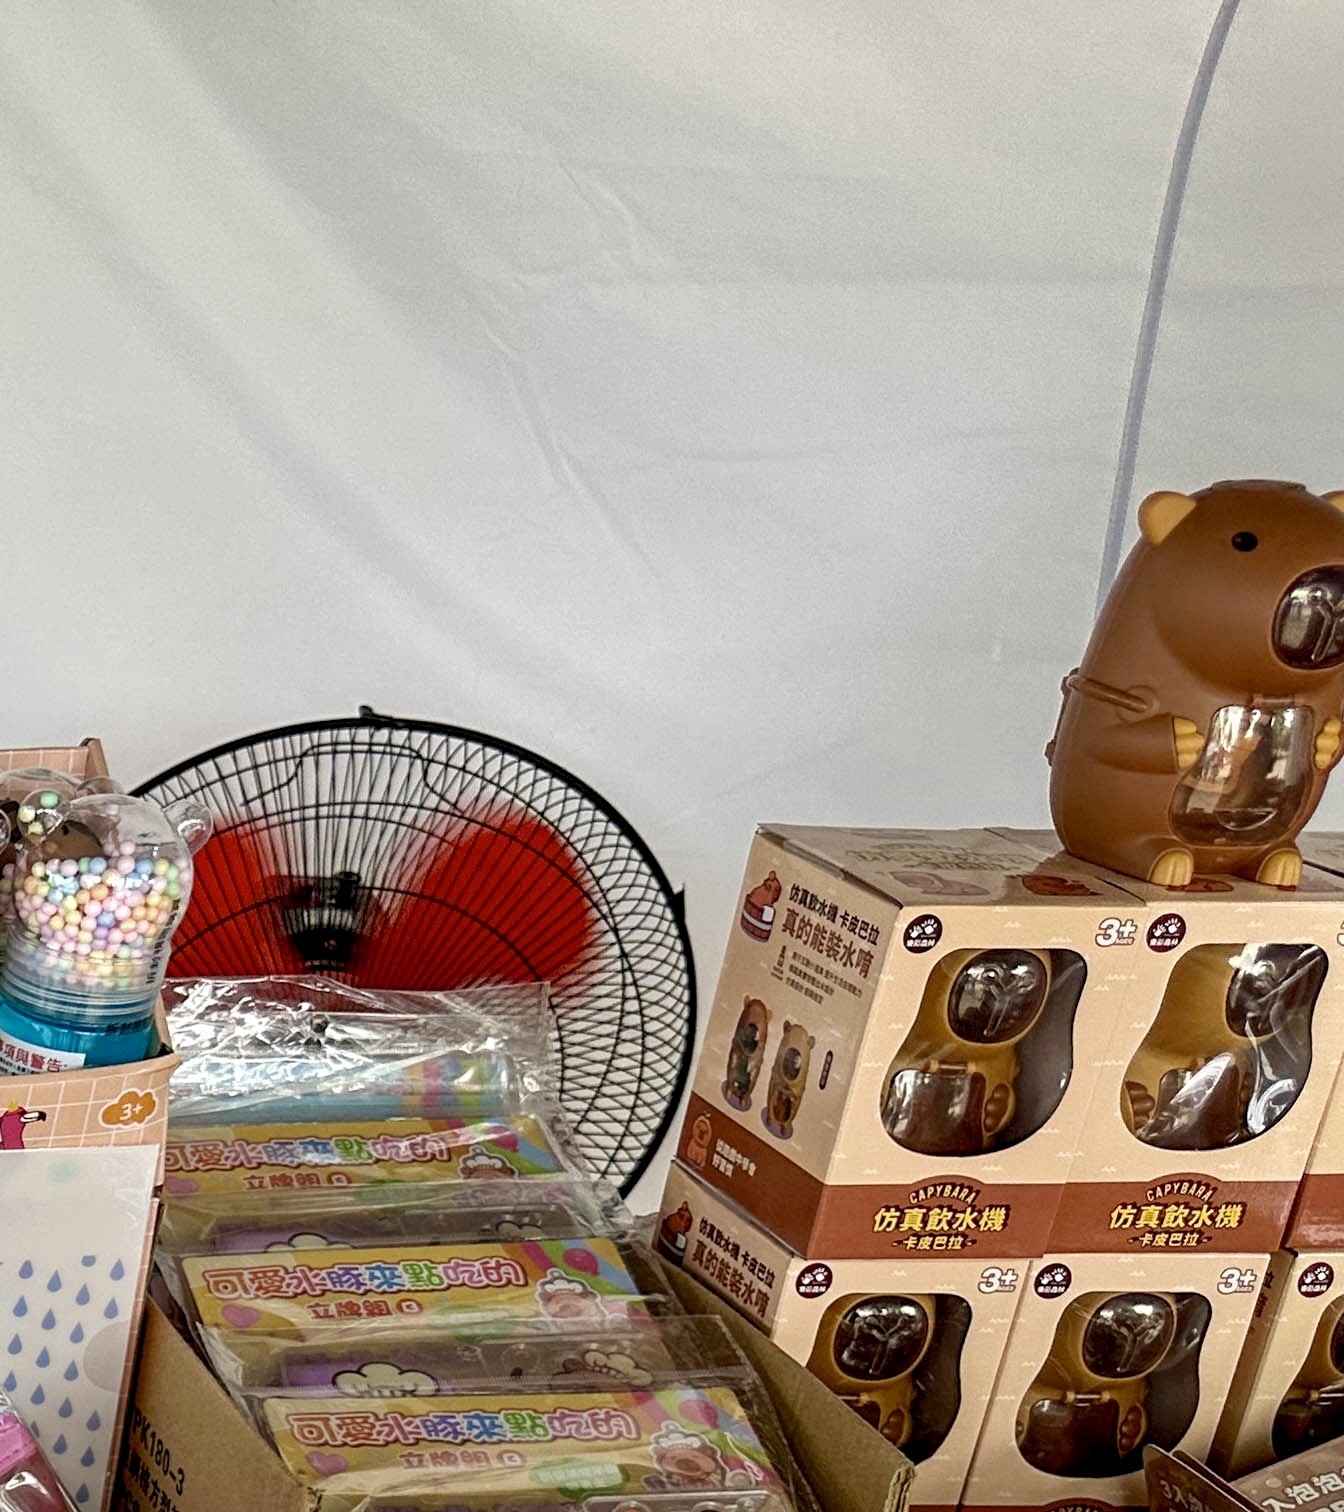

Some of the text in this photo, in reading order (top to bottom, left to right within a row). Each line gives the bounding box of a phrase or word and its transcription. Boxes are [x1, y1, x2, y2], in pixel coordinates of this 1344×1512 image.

[789, 883, 880, 945] 仿真飲水機 卡皮巴拉
[782, 908, 874, 979] 真的能裝水唷
[1095, 918, 1137, 947] 3+
[119, 1103, 144, 1119] 3+
[909, 1183, 976, 1204] CAPYBARA
[1146, 1180, 1213, 1202] CAPYBARA
[873, 1207, 1009, 1233] 仿真飲水機
[1110, 1204, 1244, 1229] 仿真飲水機
[204, 1255, 528, 1300] 可愛水豚來點吃的
[741, 1252, 776, 1289] 卡皮巴拉
[978, 1267, 1017, 1293] 3+
[1217, 1267, 1256, 1293] 3+
[306, 1300, 392, 1319] 立牌組
[287, 1409, 638, 1446] 可愛水豚來點吃的
[132, 1407, 185, 1496] PK180-3
